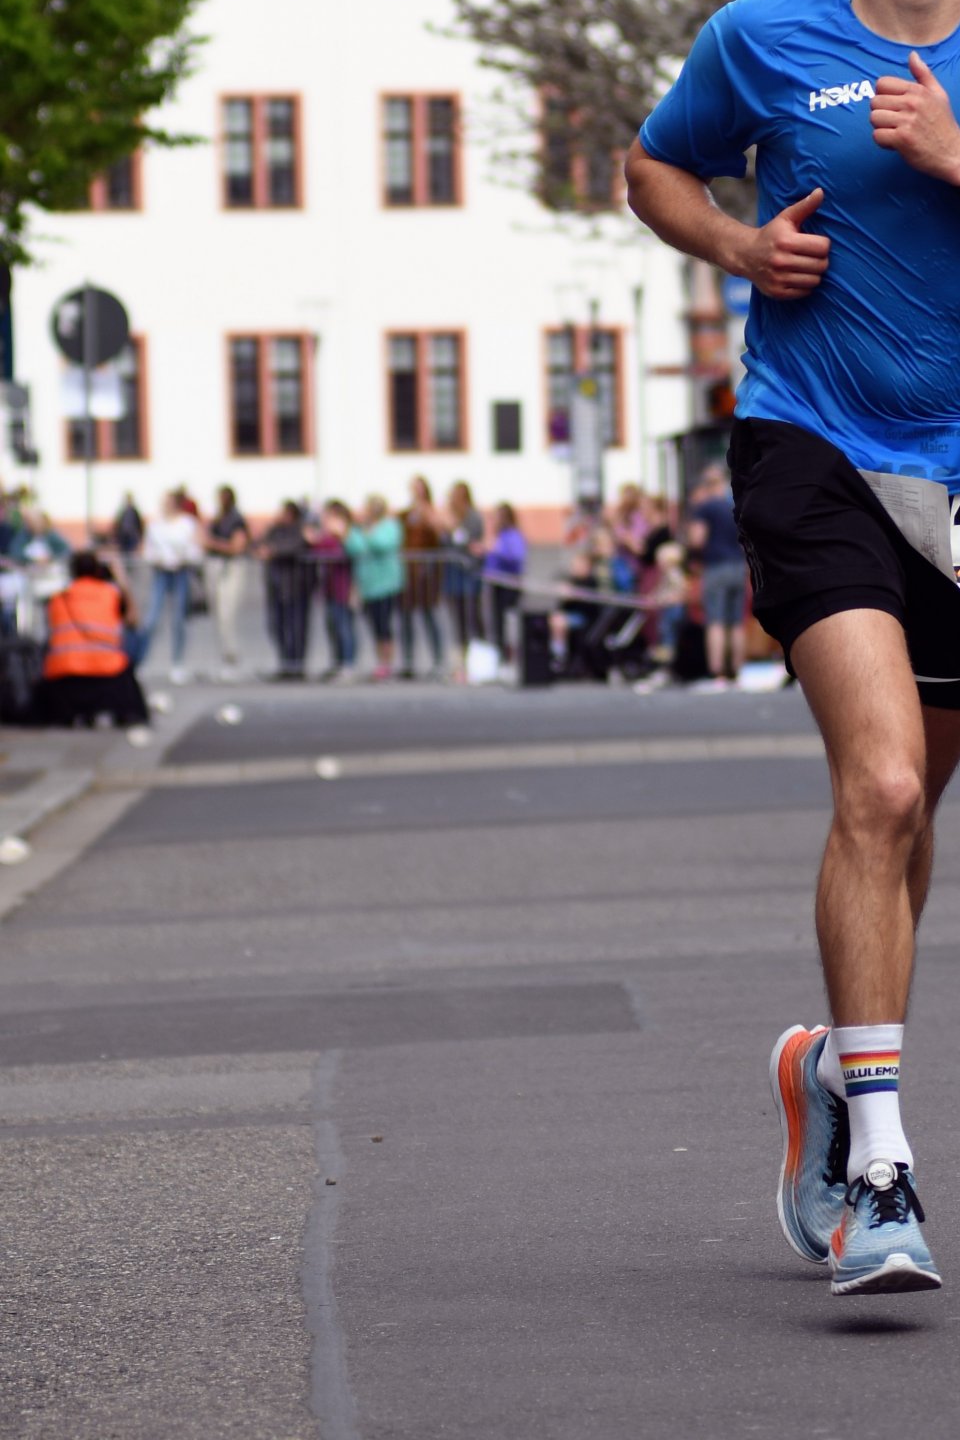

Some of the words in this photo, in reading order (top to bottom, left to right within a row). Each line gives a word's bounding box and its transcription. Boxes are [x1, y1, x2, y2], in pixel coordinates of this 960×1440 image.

[809, 80, 875, 112] HOKA
[920, 441, 949, 454] Mainz
[844, 1066, 899, 1080] LULULEMO
